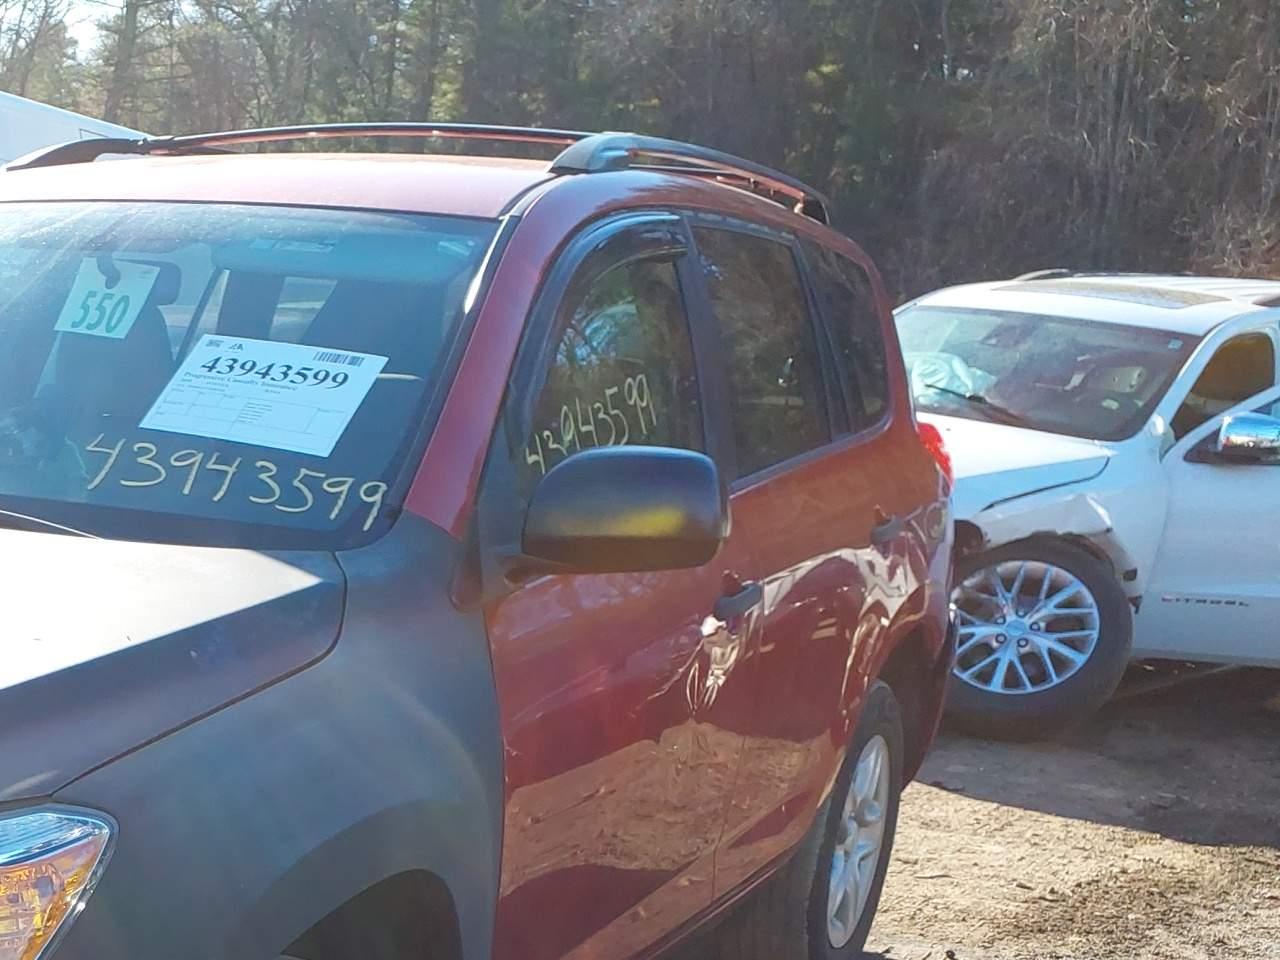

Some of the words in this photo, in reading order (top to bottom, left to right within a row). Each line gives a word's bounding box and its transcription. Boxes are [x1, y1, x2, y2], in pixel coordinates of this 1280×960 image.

[70, 290, 130, 334] 550
[200, 355, 350, 390] 43943599
[524, 373, 658, 475] 43943599
[86, 434, 388, 531] 43943599
